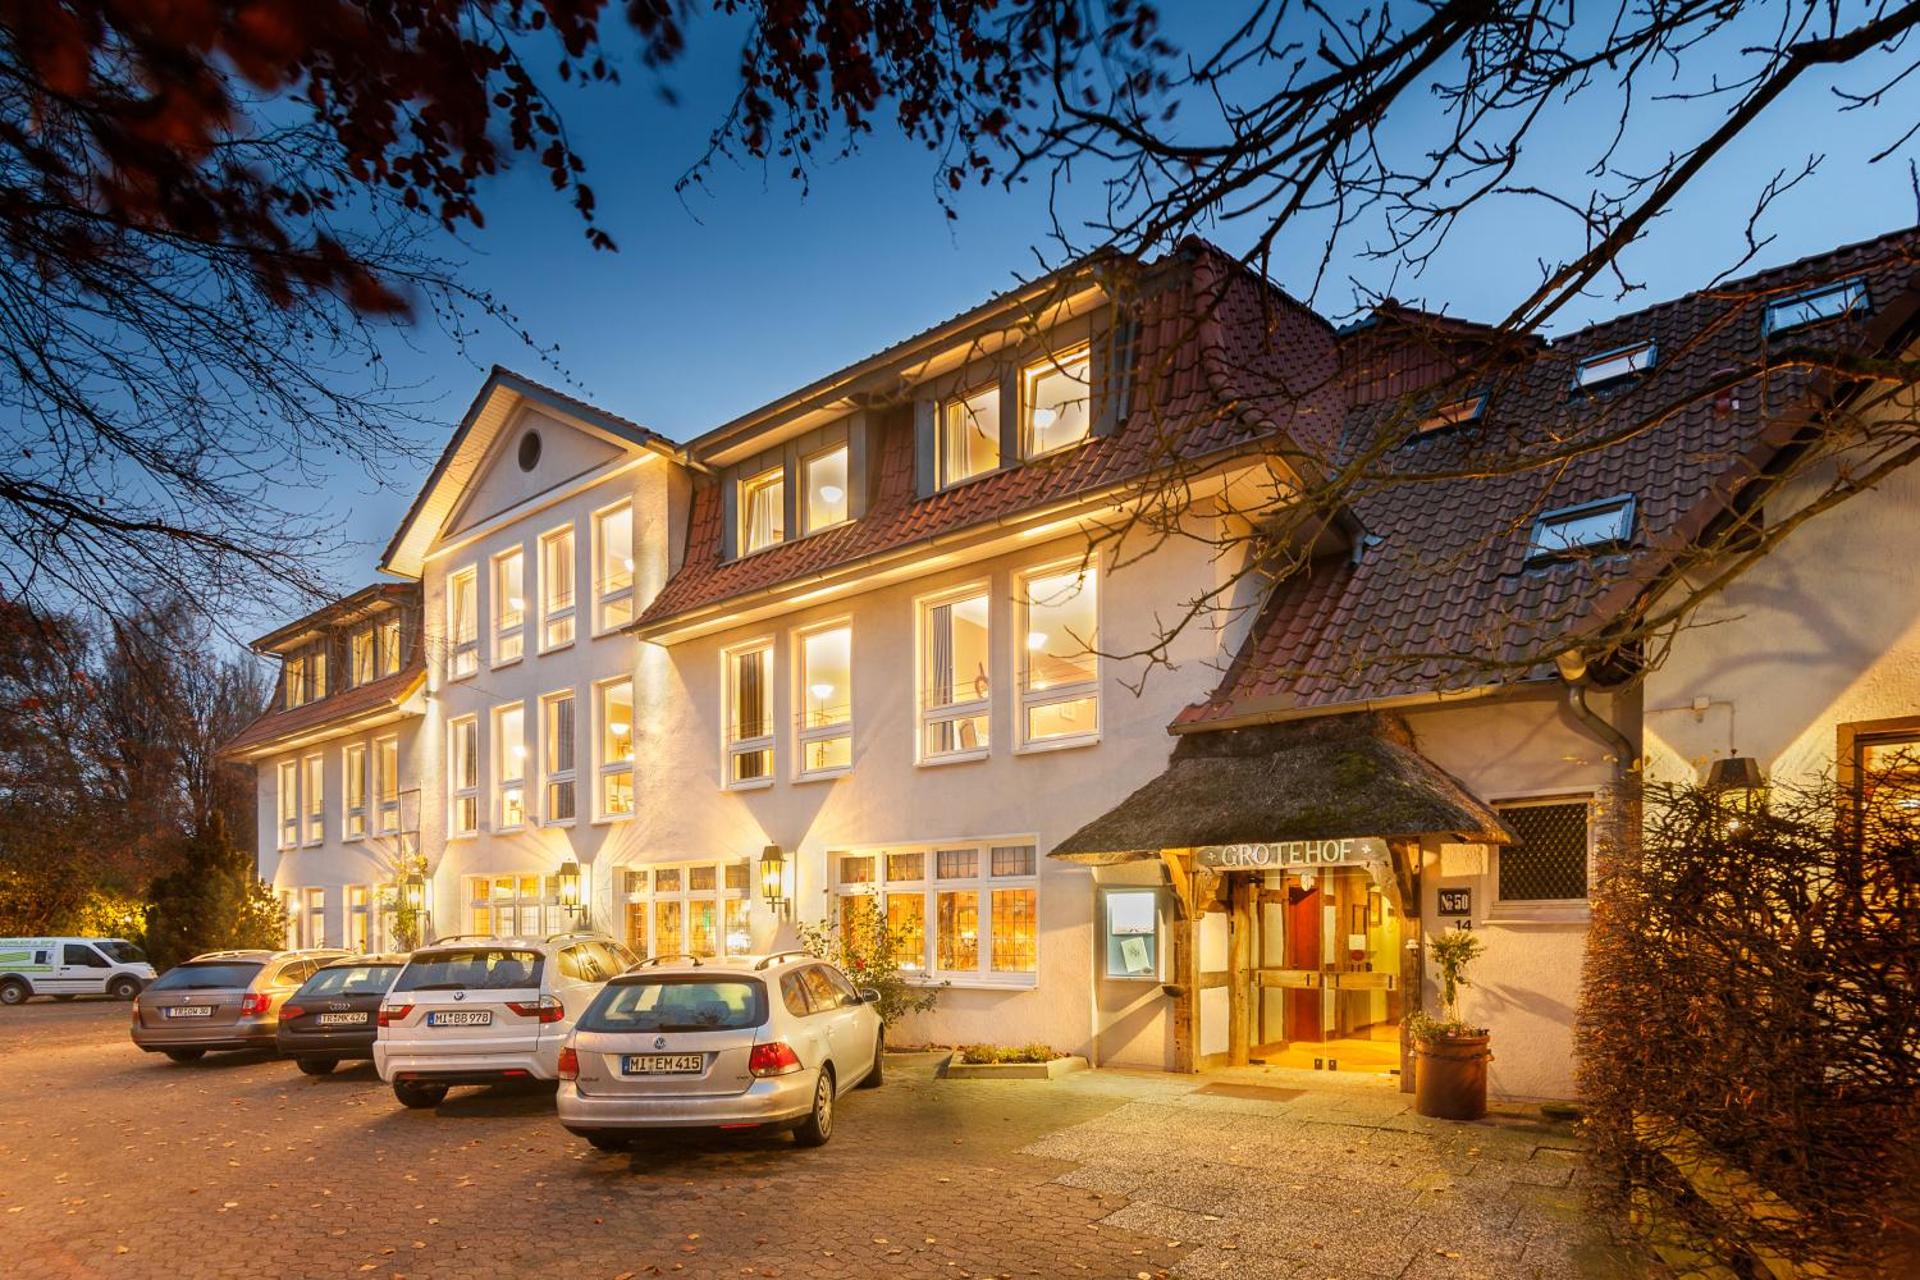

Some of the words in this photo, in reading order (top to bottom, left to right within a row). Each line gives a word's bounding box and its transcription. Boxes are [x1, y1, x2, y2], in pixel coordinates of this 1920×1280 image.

[1221, 839, 1355, 866] GROTEHOF
[1454, 894, 1468, 910] 50
[1455, 920, 1472, 931] 14
[435, 1014, 447, 1024] MI
[454, 1013, 467, 1024] BB
[469, 1013, 489, 1023] 978
[630, 1059, 646, 1070] MI
[656, 1058, 673, 1070] EM
[675, 1057, 700, 1069] 415
